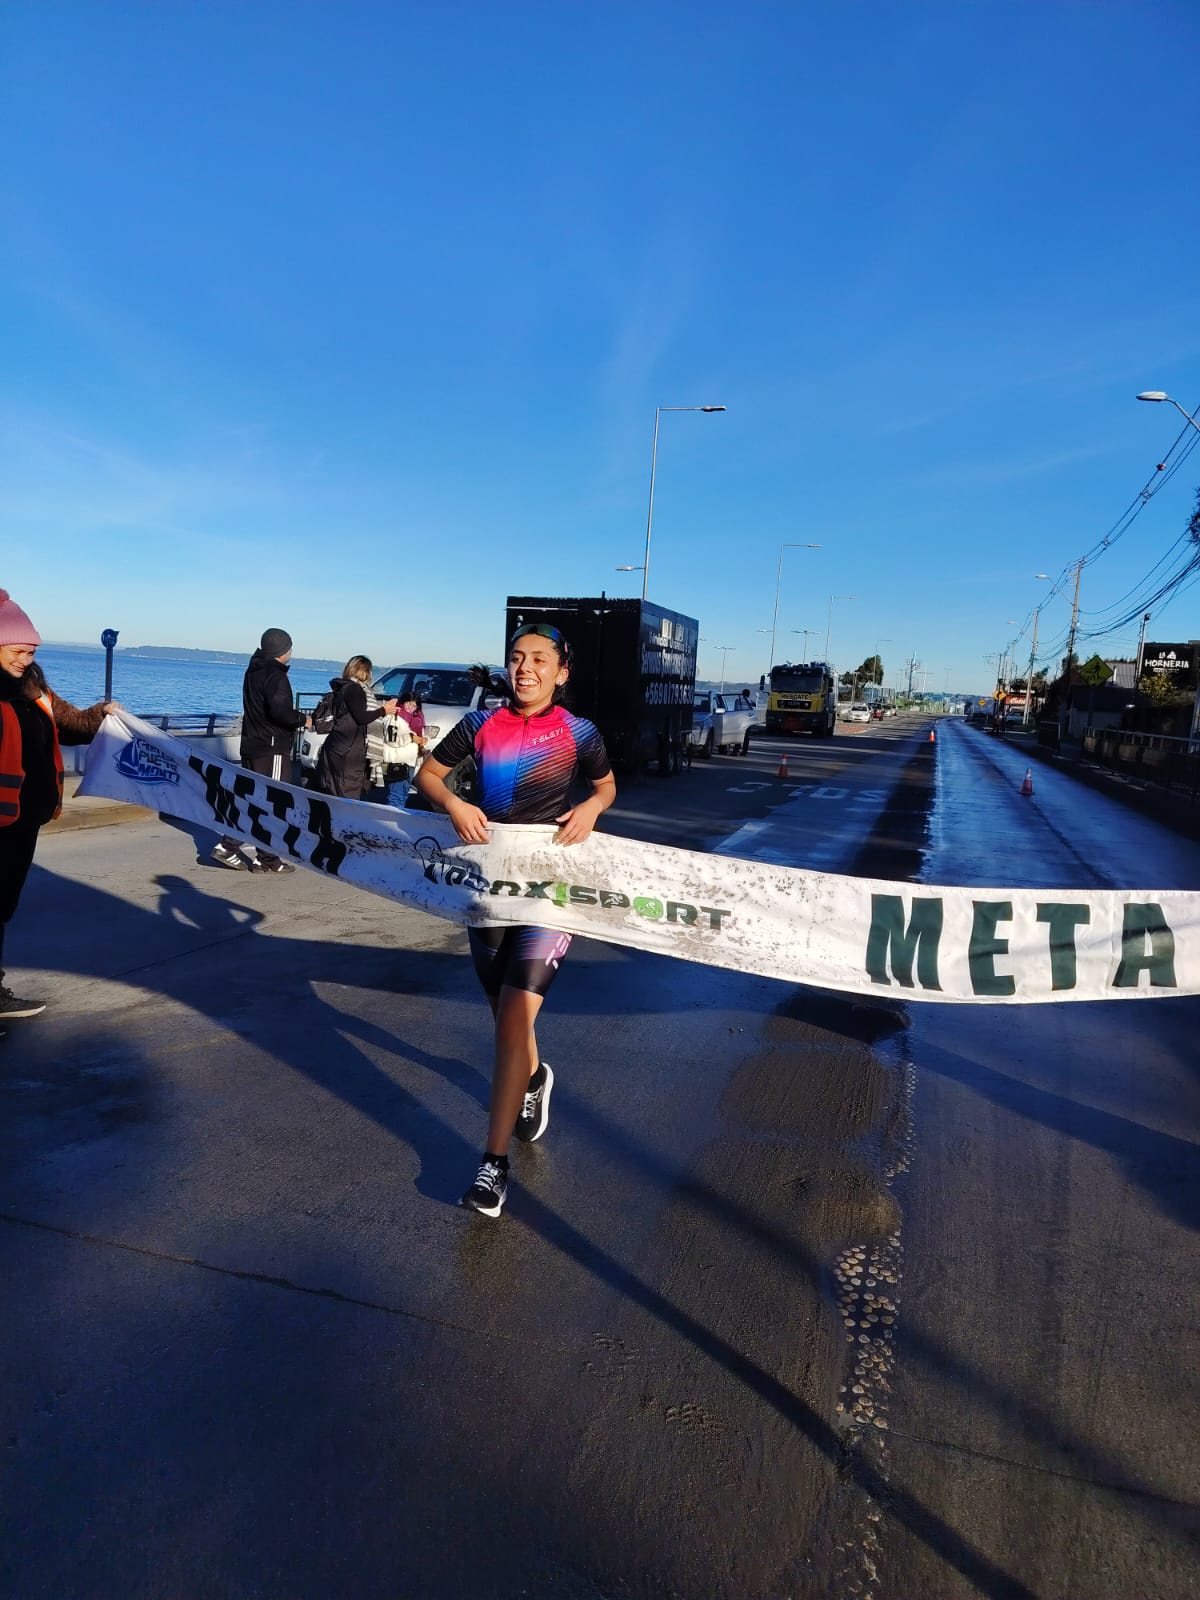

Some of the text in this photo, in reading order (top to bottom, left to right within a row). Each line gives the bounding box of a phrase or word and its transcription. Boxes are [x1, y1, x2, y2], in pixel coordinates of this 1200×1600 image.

[1145, 659, 1190, 668] HORNERIA
[188, 755, 347, 876] META
[866, 893, 1178, 996] META
